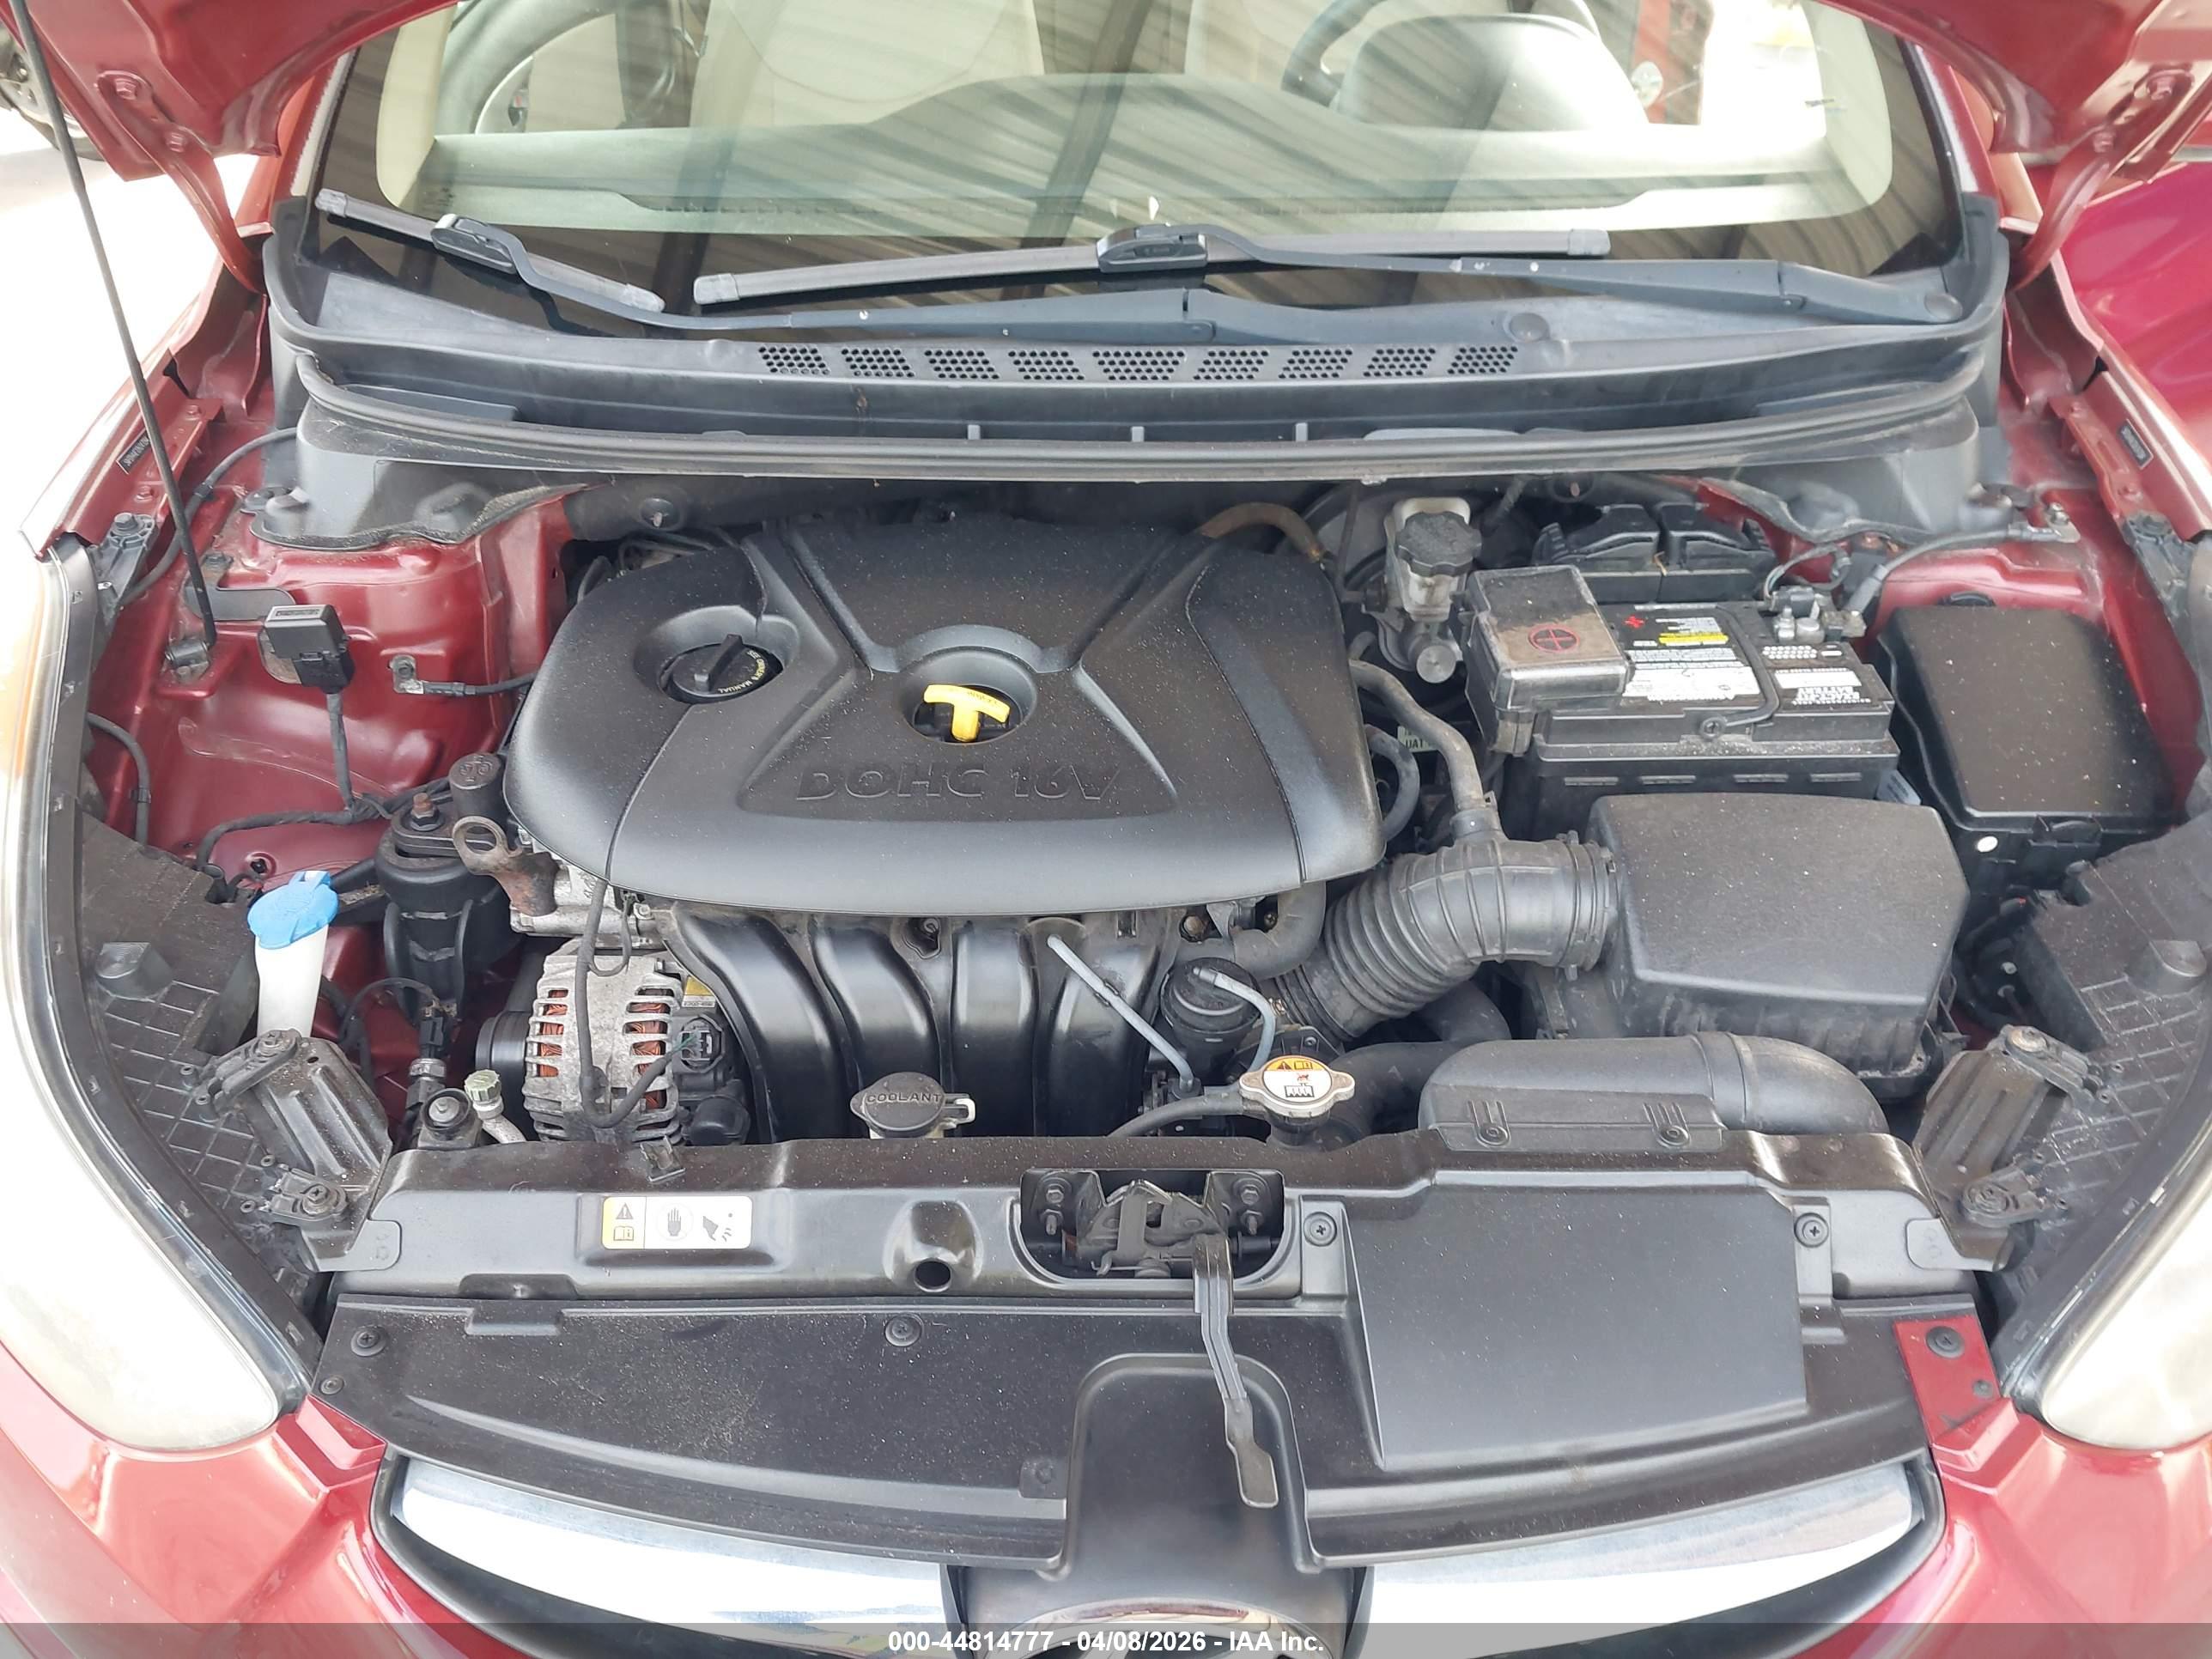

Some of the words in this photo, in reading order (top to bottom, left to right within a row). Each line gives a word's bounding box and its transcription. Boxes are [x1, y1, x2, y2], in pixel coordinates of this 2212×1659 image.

[718, 679, 752, 693] MANUAL
[796, 763, 988, 800] DOHC
[1011, 764, 1120, 800] 16V
[866, 1092, 942, 1104] COOLANT
